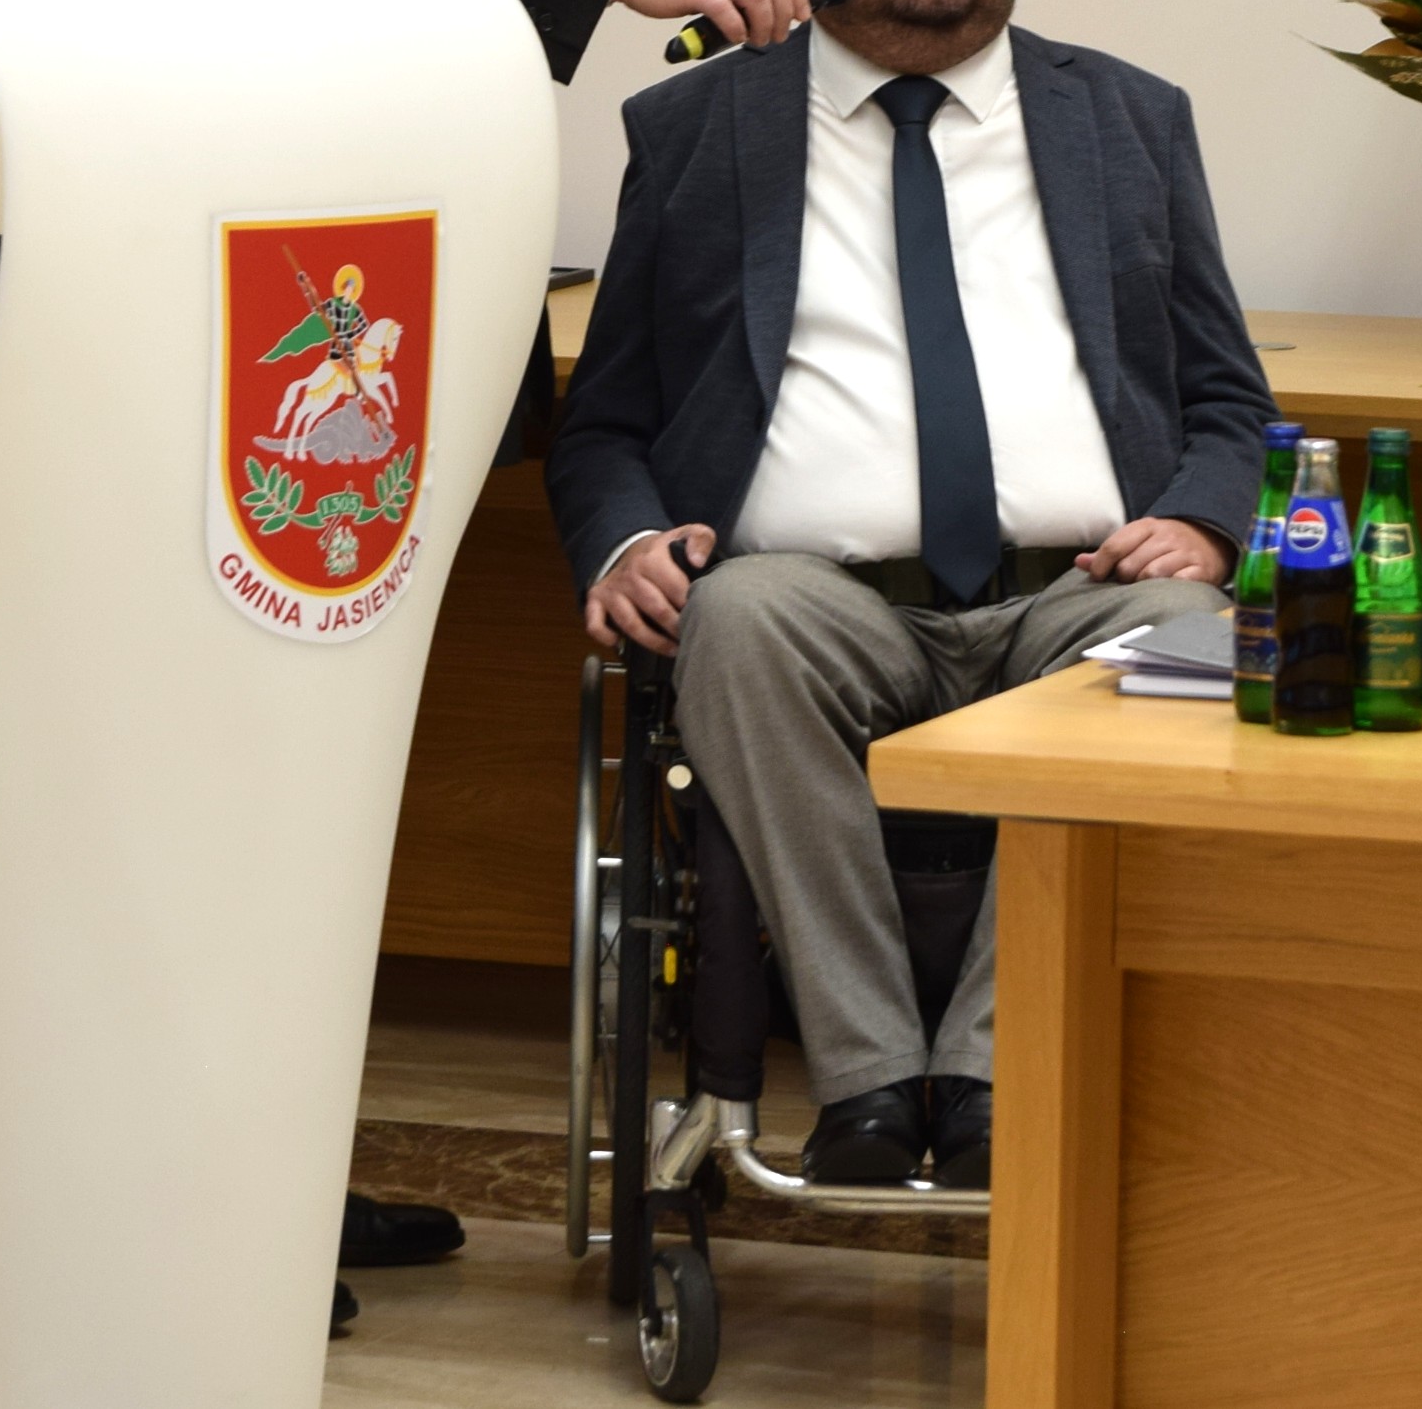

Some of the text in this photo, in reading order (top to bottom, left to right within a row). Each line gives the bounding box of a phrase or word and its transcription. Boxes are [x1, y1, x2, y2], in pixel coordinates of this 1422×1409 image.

[1289, 523, 1323, 535] PEPSI
[219, 535, 421, 631] GMINA JASIENICA
